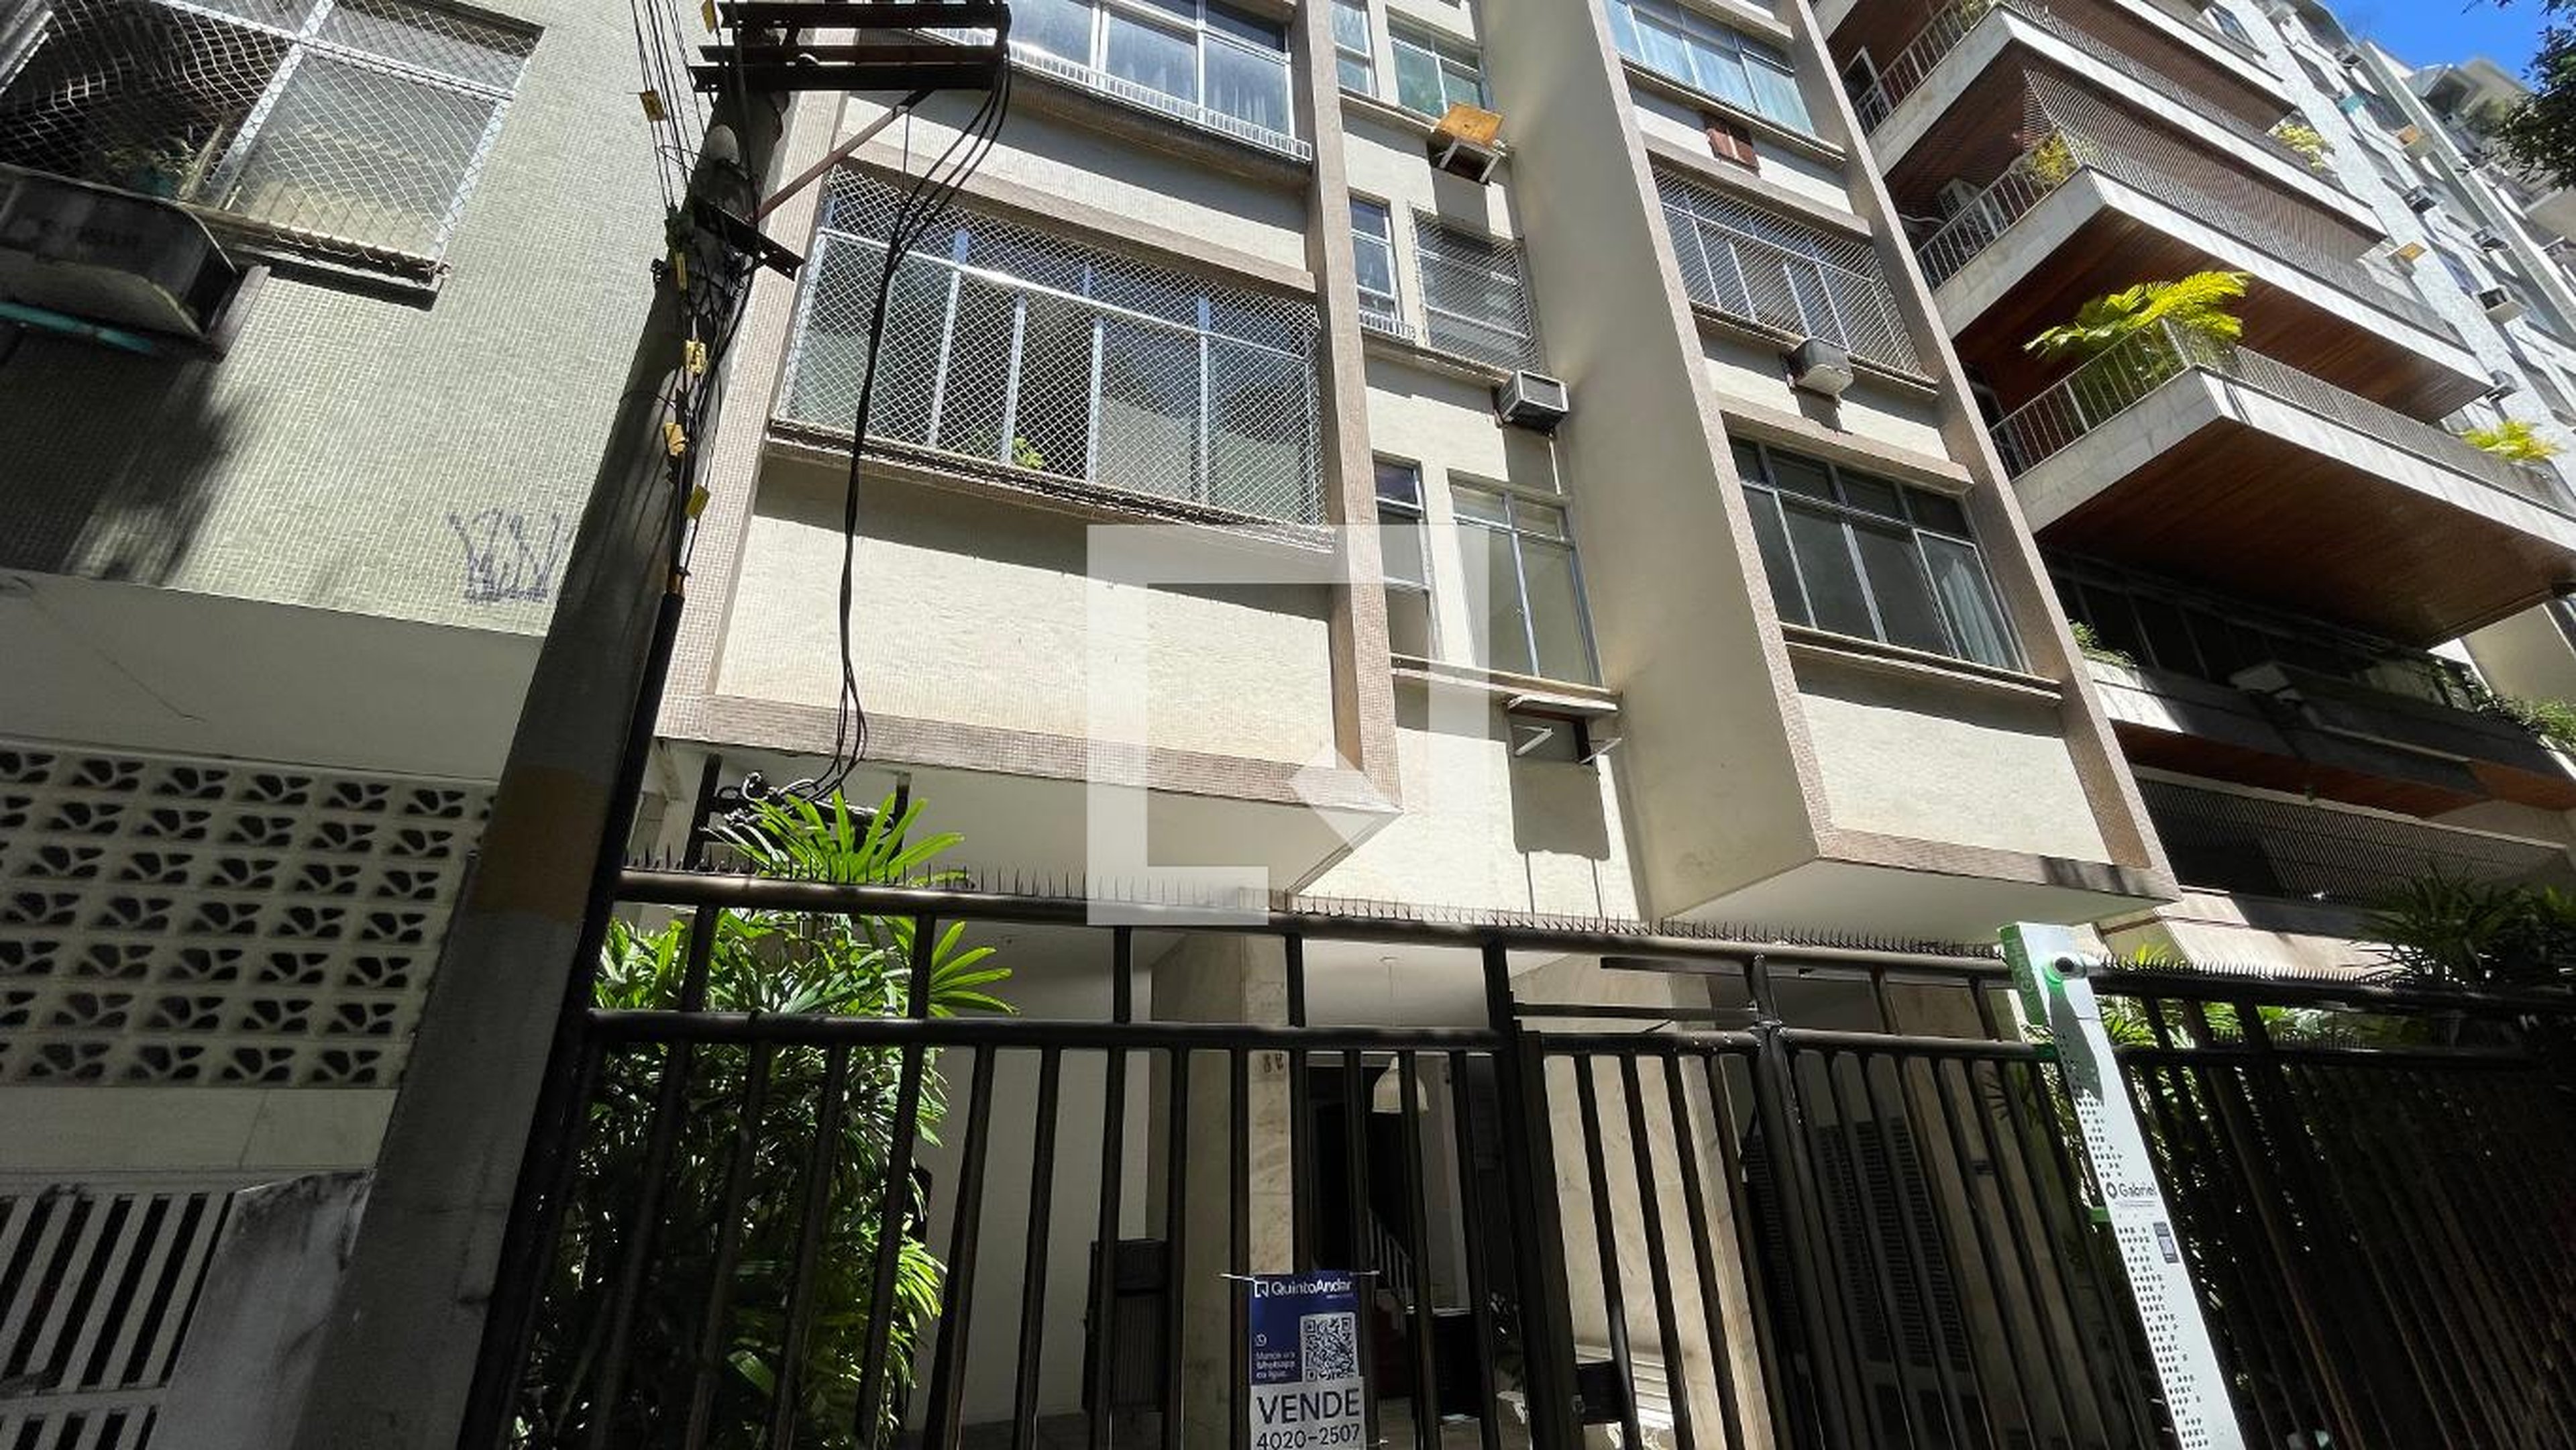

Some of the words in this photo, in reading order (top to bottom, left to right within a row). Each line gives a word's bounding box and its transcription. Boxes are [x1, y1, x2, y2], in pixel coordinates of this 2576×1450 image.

[2118, 1182, 2157, 1197] Gabriel
[1271, 1278, 1352, 1296] QuintoAndar
[1257, 1388, 1360, 1424] VENDE
[1256, 1423, 1360, 1450] 4020-2507
